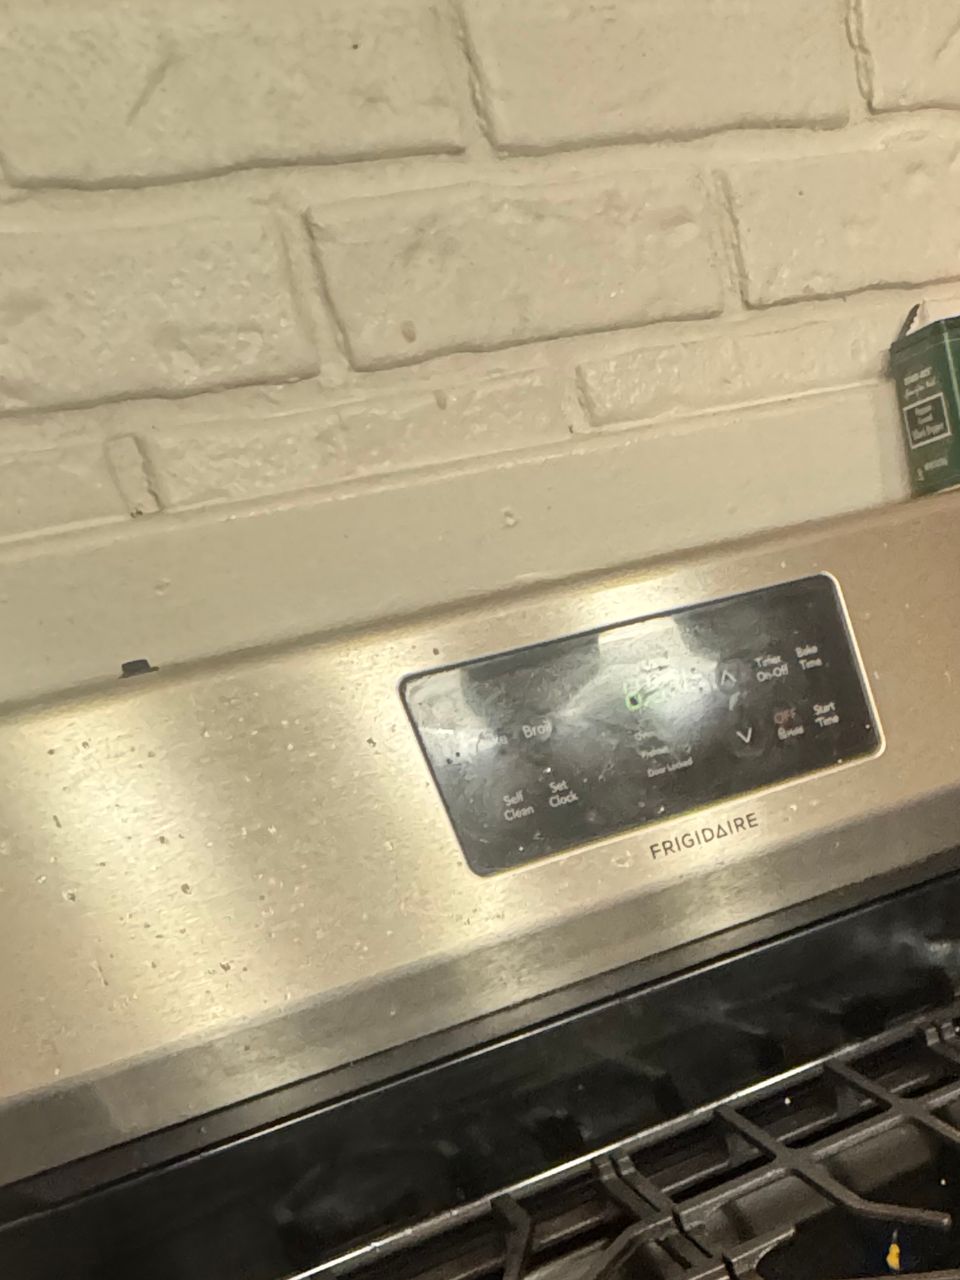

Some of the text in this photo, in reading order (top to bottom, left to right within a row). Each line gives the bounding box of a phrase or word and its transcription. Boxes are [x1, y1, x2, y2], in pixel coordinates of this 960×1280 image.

[549, 780, 568, 793] Set
[503, 789, 524, 806] Self
[549, 790, 579, 808] Clock
[504, 806, 535, 821] Clean
[649, 812, 759, 860] FRIGIDAIRE
